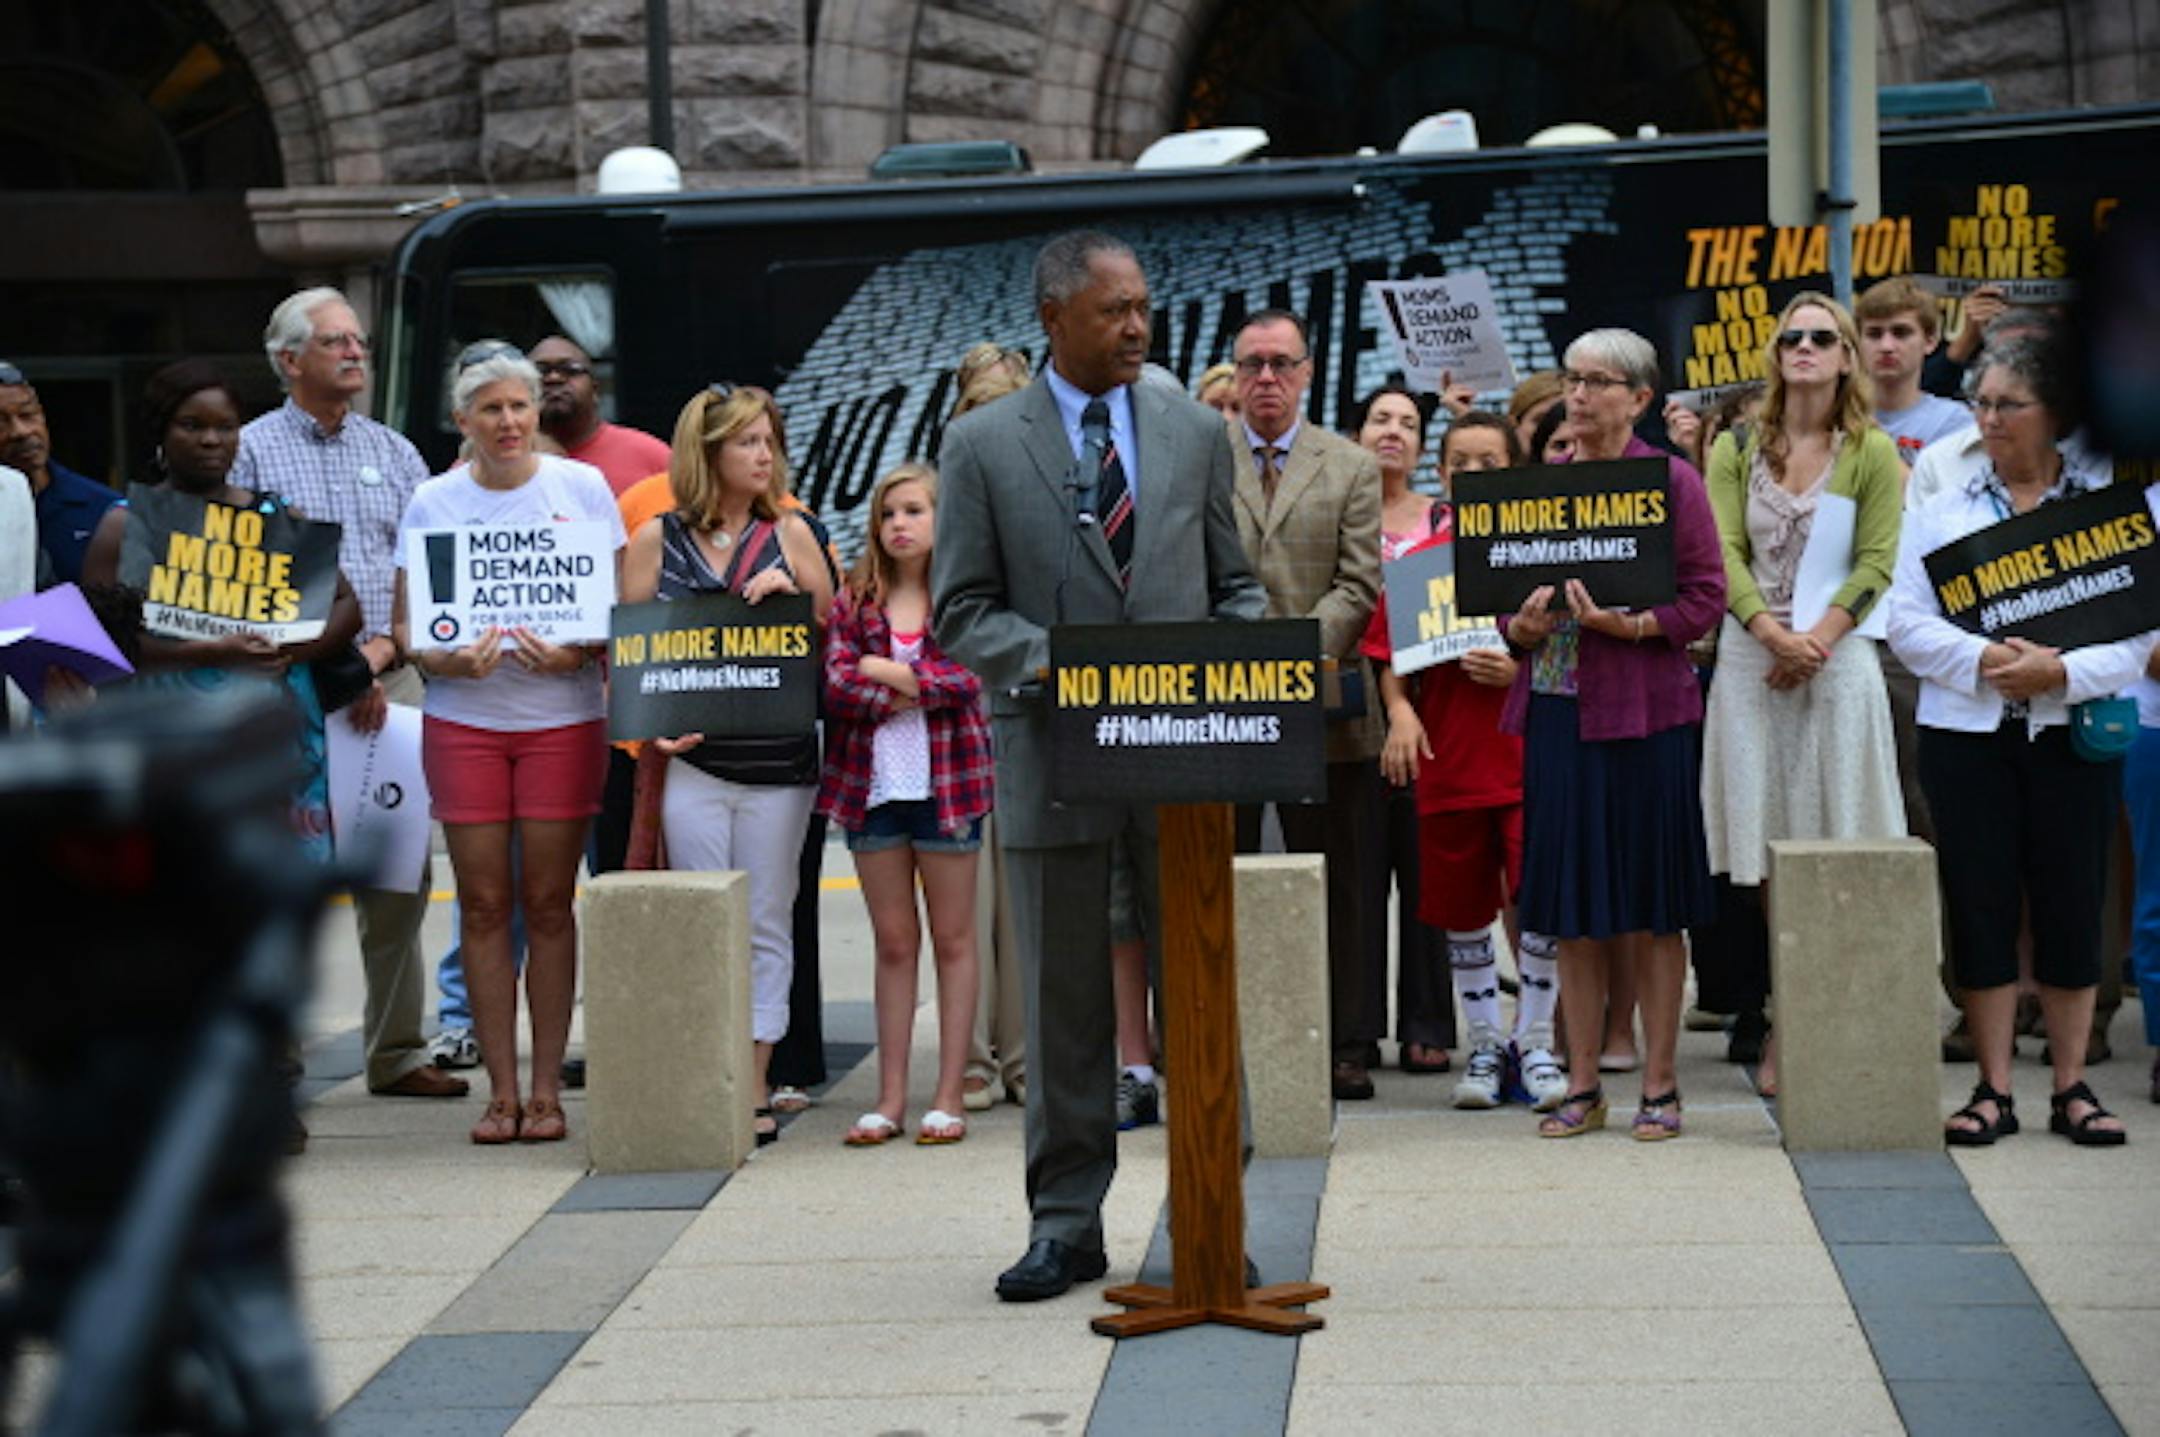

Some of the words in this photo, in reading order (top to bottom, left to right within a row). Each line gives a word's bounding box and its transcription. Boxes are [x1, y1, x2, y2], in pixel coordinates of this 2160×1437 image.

[1977, 185, 2029, 218] NO
[1685, 225, 1766, 289] THE
[1768, 215, 1912, 281] NAION
[1949, 215, 2057, 248] MORE
[1936, 246, 2068, 279] NAMES
[1716, 285, 1769, 322] NO
[1692, 315, 1778, 357] MOR
[792, 383, 909, 515] NO
[204, 502, 264, 548] NO
[1458, 502, 1493, 537] NO
[1499, 496, 1569, 535] MORE
[1574, 489, 1667, 528] NAMES
[167, 531, 294, 589] MORE
[470, 528, 556, 555] MOMS
[470, 554, 595, 581] DEMAND
[1939, 574, 1977, 616] NO
[1973, 543, 2055, 599] MORE
[2052, 512, 2156, 571] NAMES
[149, 564, 302, 623] NAMES
[471, 582, 577, 609] ACTION
[615, 633, 646, 667] NO
[650, 626, 718, 663] MORE
[721, 624, 810, 658] NAMES
[1057, 665, 1102, 709] NO
[1109, 663, 1198, 706] MORE
[1205, 660, 1316, 704] NAMES
